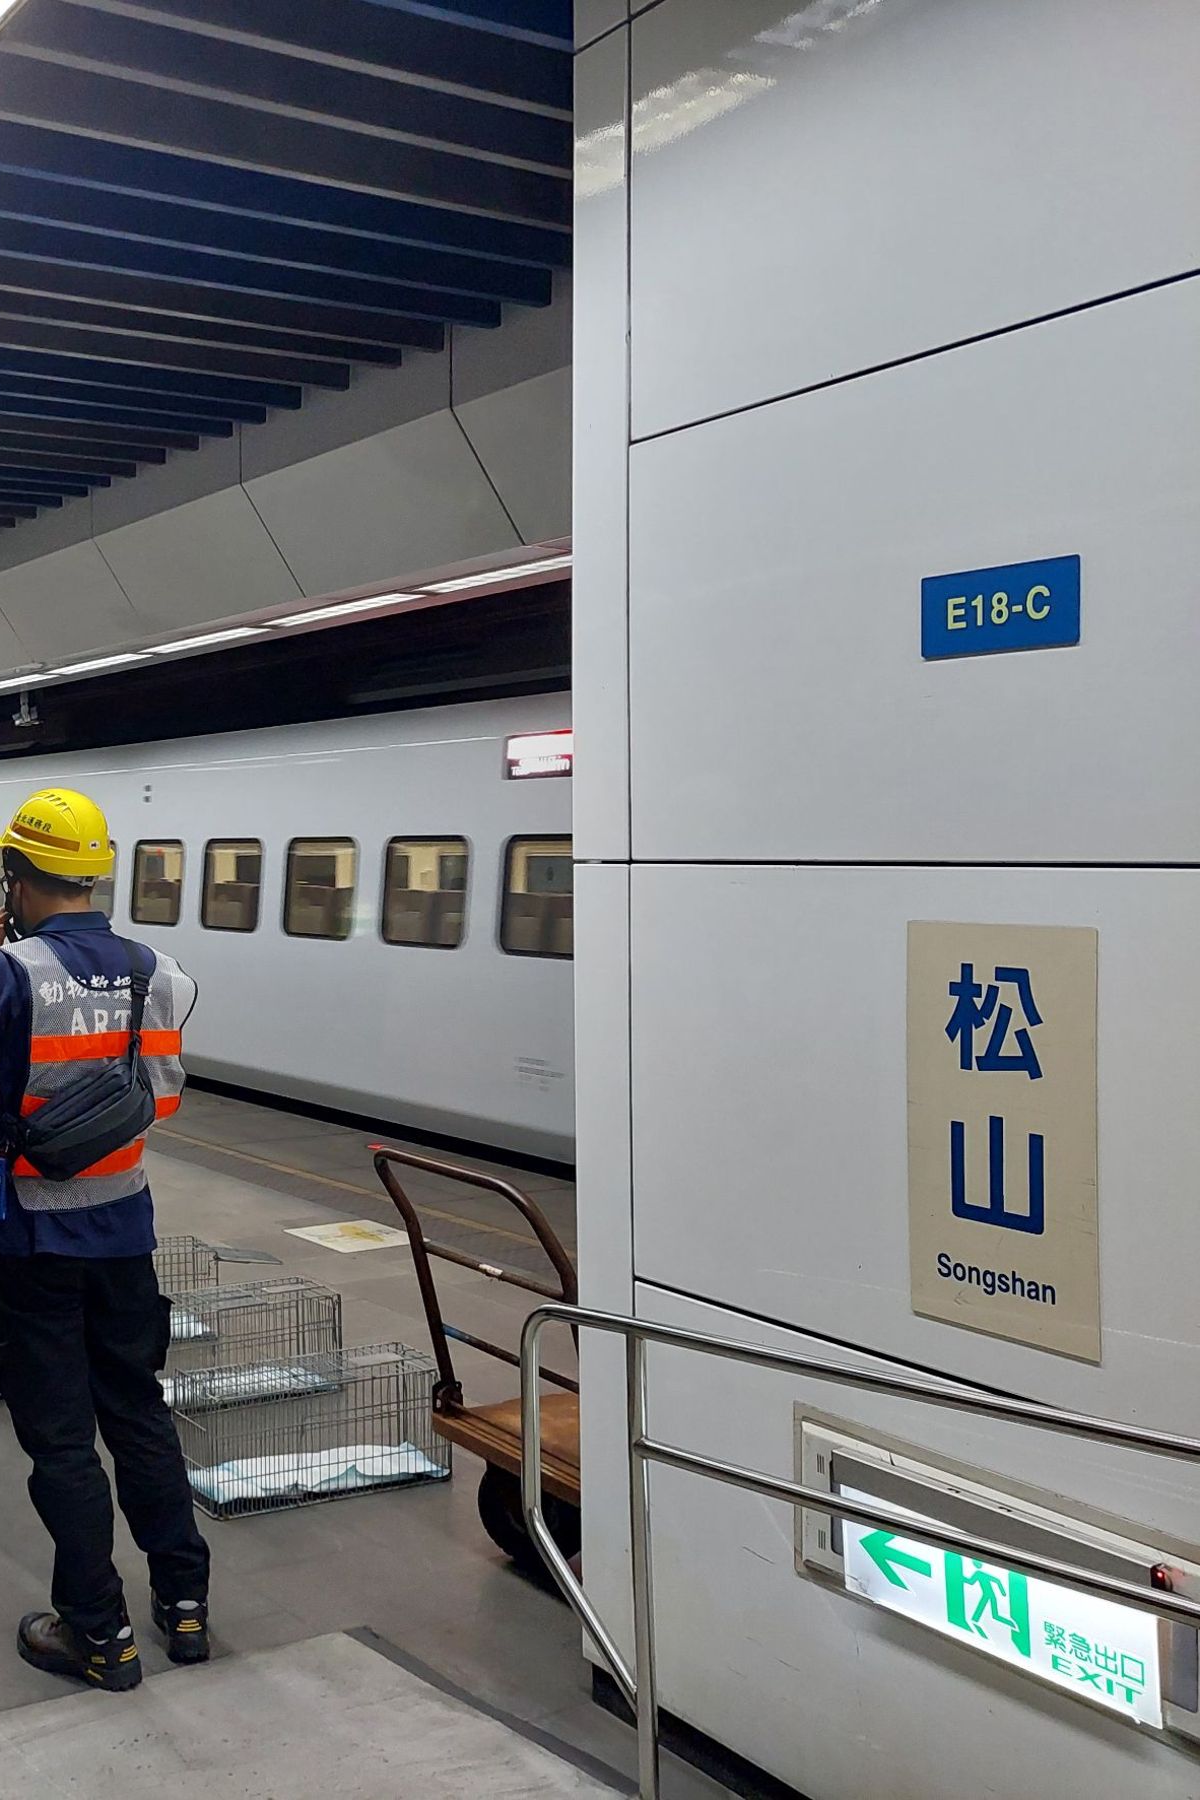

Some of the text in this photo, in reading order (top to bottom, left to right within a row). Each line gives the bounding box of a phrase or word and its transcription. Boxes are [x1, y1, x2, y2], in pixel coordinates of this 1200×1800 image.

[947, 585, 1050, 630] E18-C
[39, 974, 152, 1006] 動物救援
[71, 1007, 132, 1036] ART
[945, 963, 1043, 1235] 松山
[937, 1253, 1056, 1305] Songshan
[1044, 1621, 1144, 1687] 緊急出口
[1051, 1654, 1143, 1704] EXIT
